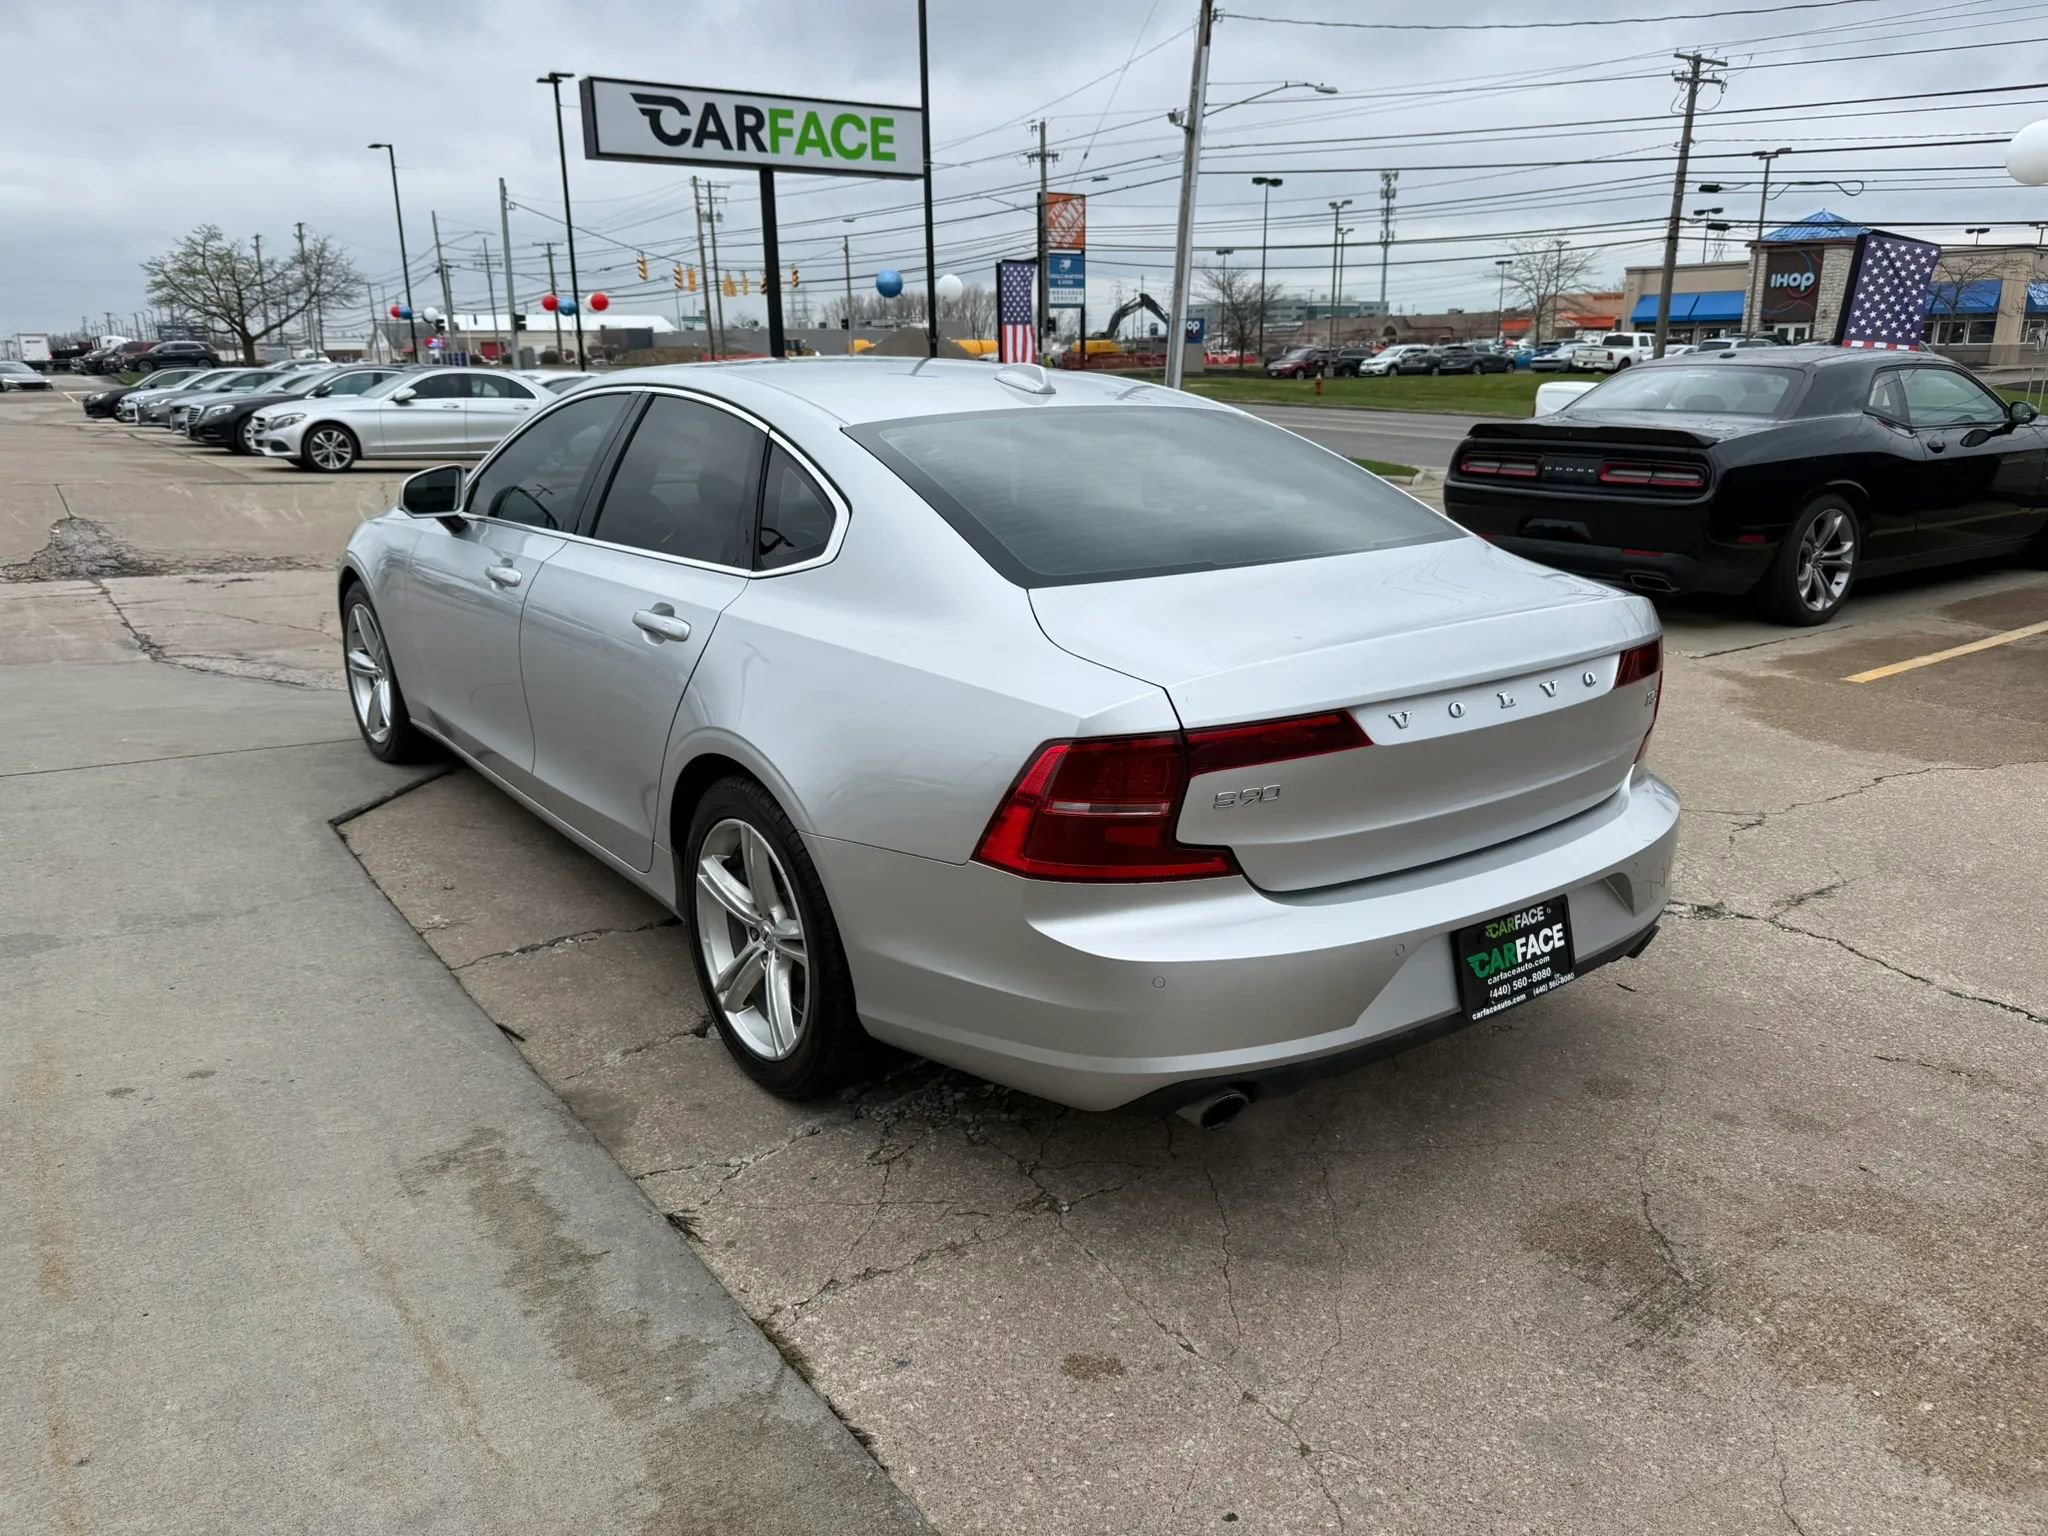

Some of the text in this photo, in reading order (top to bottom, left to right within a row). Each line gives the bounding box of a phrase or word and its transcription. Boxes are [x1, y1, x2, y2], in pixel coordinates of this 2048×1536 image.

[630, 92, 896, 162] CARFACE
[1770, 271, 1815, 291] IHOP
[1544, 465, 1595, 473] DODGE
[1388, 670, 1598, 730] VOLVO
[1213, 784, 1281, 810] S90
[1485, 905, 1545, 939] CARFACE
[1466, 923, 1565, 978] CARFACE
[1487, 955, 1550, 985] carfaceauto.com
[1489, 983, 1511, 999] (440)
[1471, 994, 1527, 1020] carfaceauto.com
